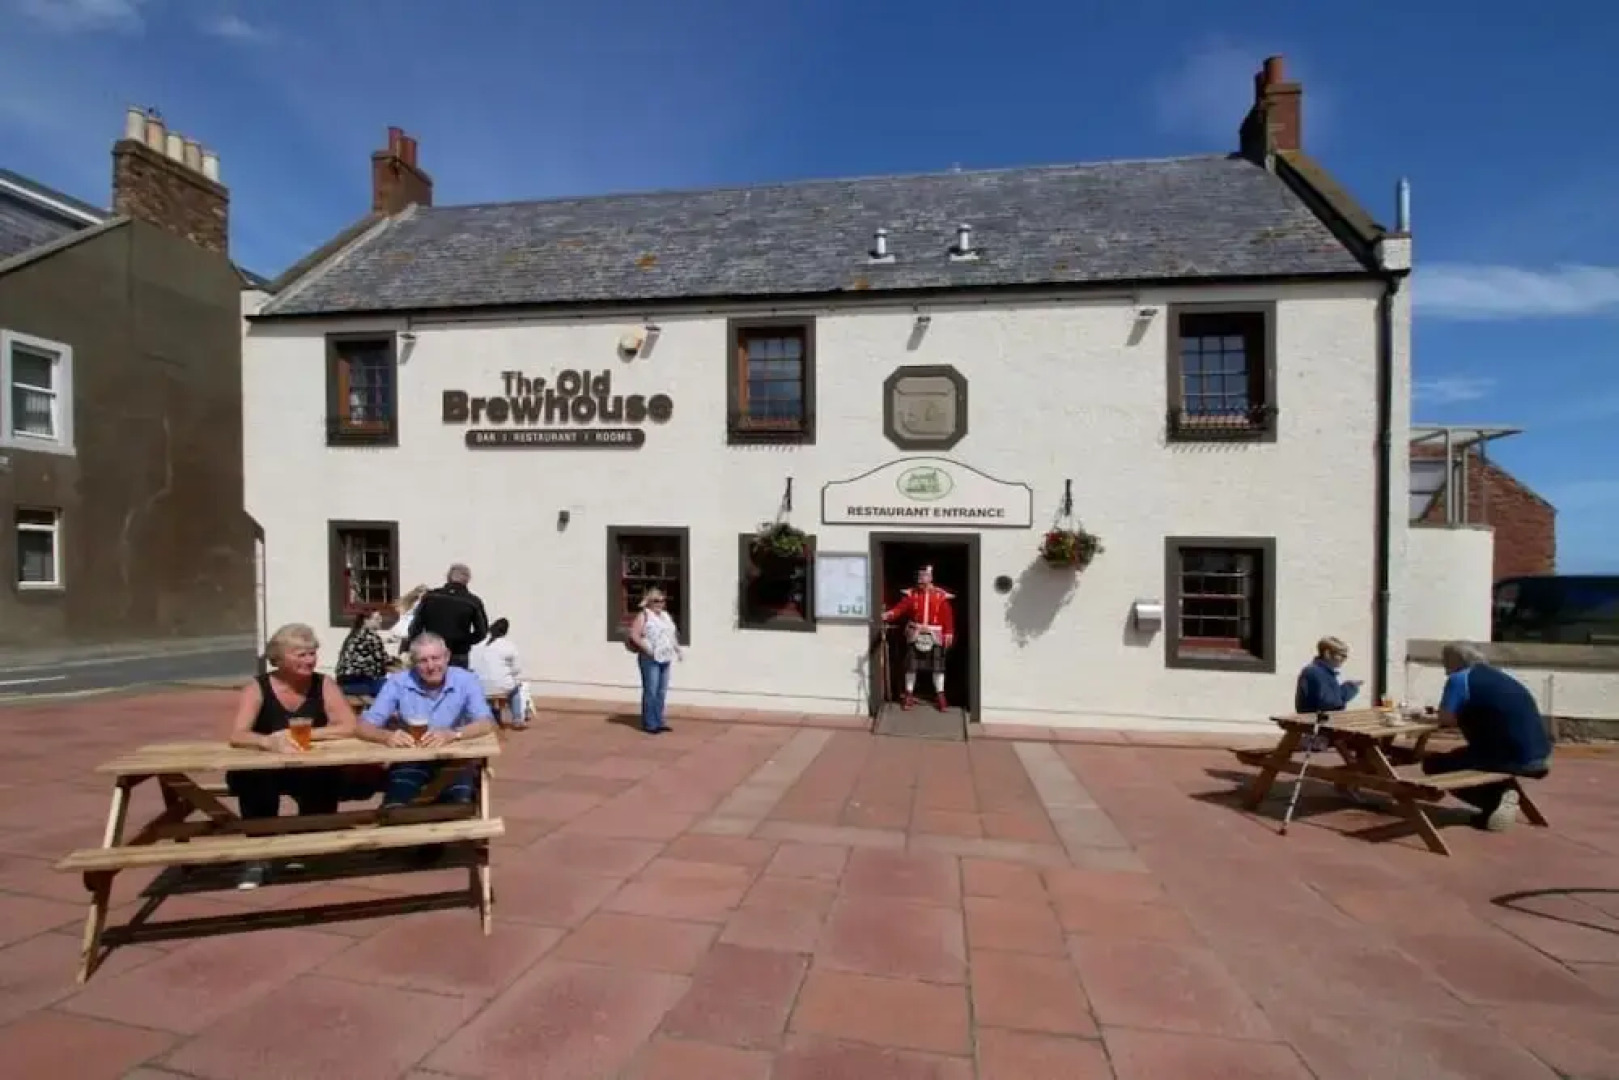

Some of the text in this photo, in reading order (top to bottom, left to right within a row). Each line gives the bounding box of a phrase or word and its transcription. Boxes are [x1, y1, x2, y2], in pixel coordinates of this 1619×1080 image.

[501, 369, 612, 397] The Old
[442, 388, 674, 424] Brewhouse
[475, 431, 633, 442] BAR RESTAURANT ROOMS
[847, 506, 1005, 519] RESTAURANT ENTRANCE
